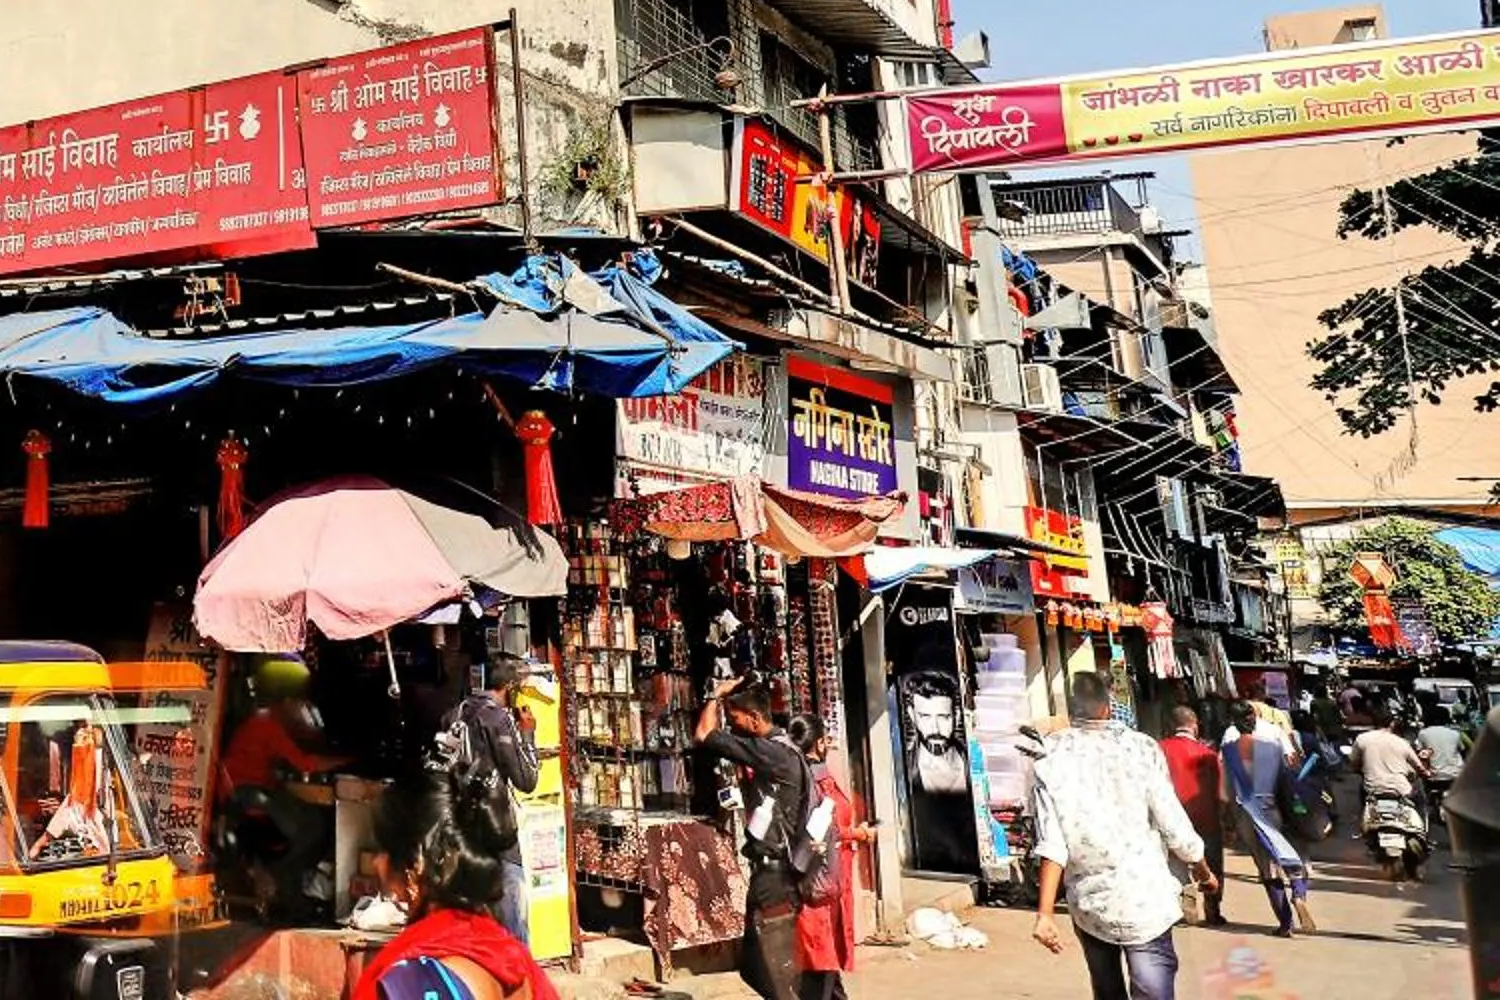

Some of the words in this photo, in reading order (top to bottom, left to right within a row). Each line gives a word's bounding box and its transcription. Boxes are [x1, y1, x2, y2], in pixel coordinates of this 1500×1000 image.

[330, 80, 348, 113] श्री
[354, 74, 385, 108] ओम
[390, 63, 419, 105] साई
[424, 62, 473, 96] विवाह
[1083, 77, 1180, 111] जांभळी
[1191, 72, 1262, 100] नाका
[1271, 60, 1382, 90] खारकर
[1395, 42, 1484, 76] आळी
[921, 106, 1036, 164] दिपावली
[952, 95, 996, 126] शुभ
[1152, 112, 1183, 137] सर्व
[1190, 104, 1297, 134] नागरिकांना
[1304, 92, 1390, 122] दिपावली
[1396, 93, 1413, 110] व
[21, 132, 57, 183] साई
[60, 128, 120, 172] विवाह
[131, 125, 194, 158] कार्यालय
[215, 157, 252, 187] विवाह
[792, 388, 855, 456] नगिना
[810, 459, 848, 489] NAGINA
[850, 468, 880, 494] STORE
